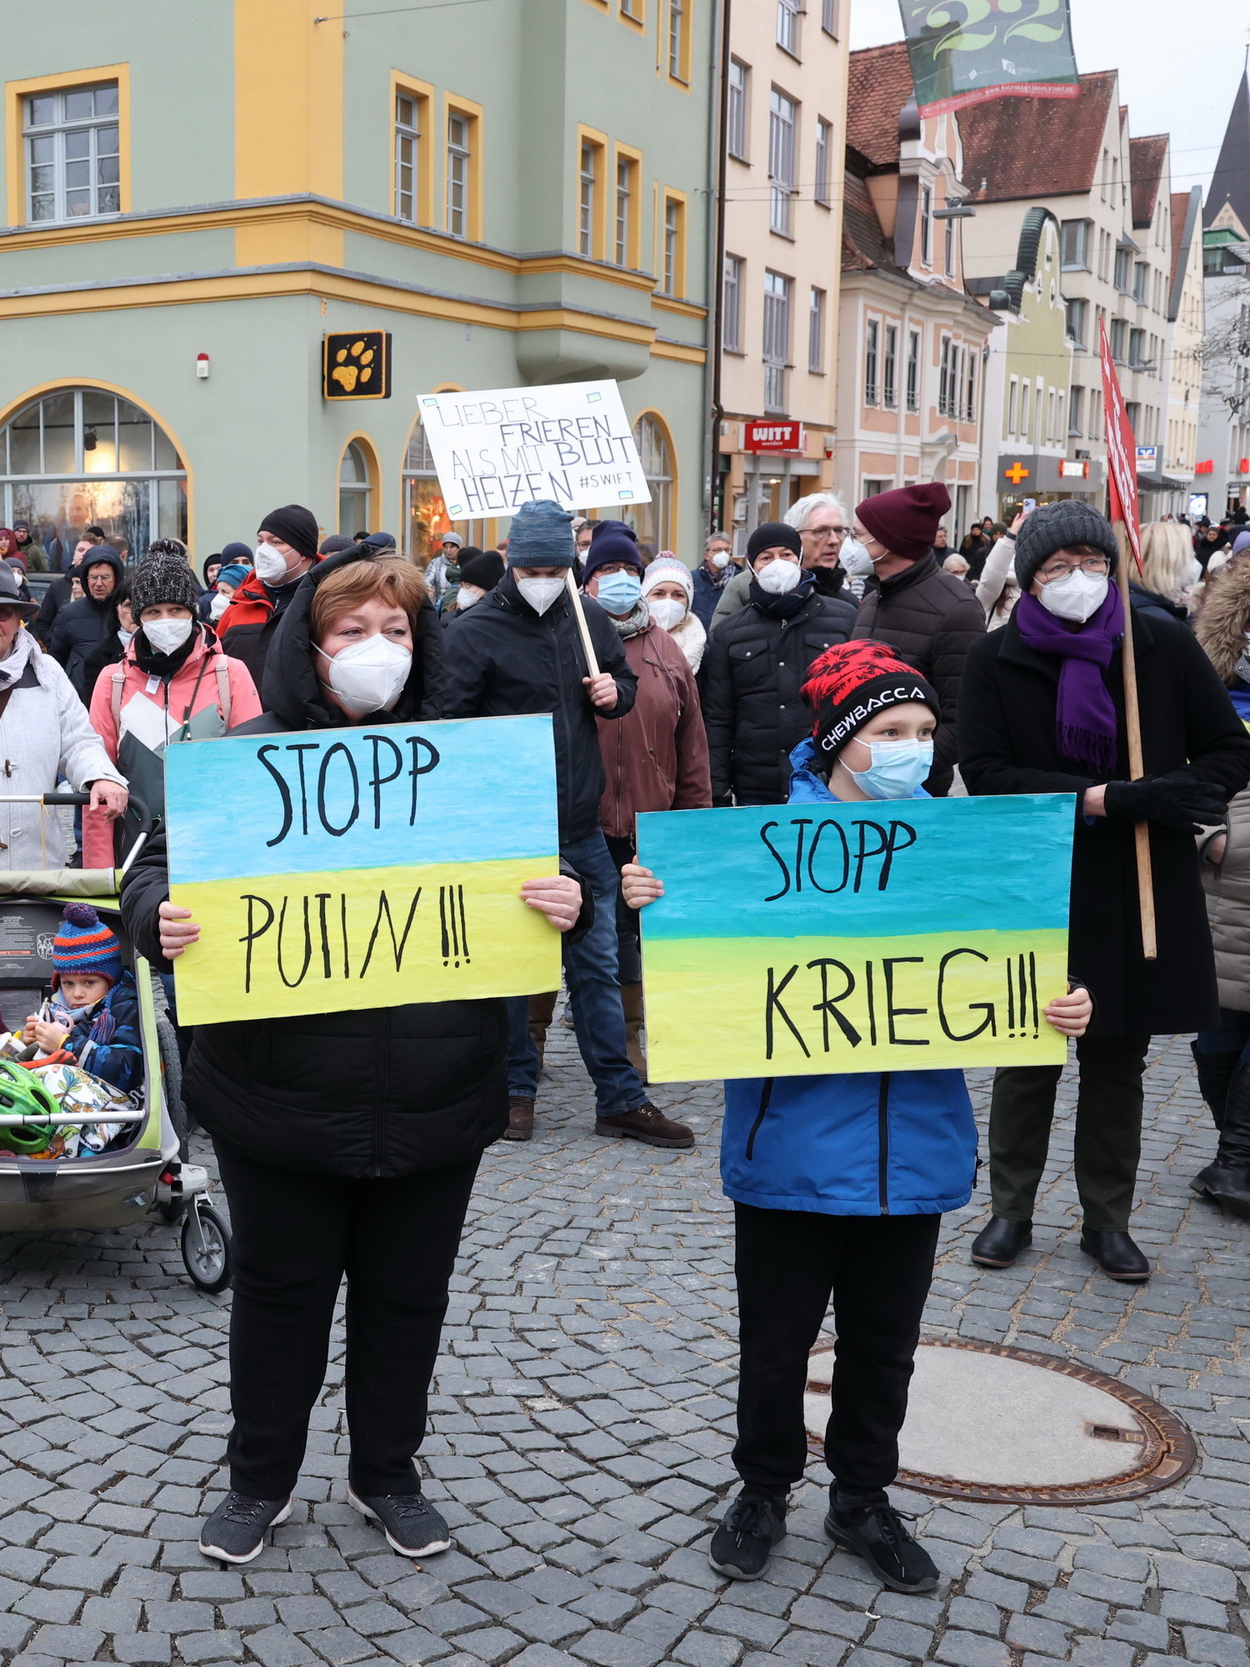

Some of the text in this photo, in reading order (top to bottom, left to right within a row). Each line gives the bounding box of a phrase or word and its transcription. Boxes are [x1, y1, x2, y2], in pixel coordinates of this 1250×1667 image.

[436, 397, 549, 427] LIEBER
[500, 414, 611, 447] FRIEREN
[752, 427, 792, 441] WITT
[451, 435, 632, 479] ALS MIT BLUT
[460, 469, 633, 512] HEIZEN #SWIFT
[821, 686, 926, 751] CHEWBACCA
[257, 735, 440, 847] STOPP
[760, 819, 917, 902] STOPP
[766, 948, 1039, 1060] KRIEG!!!
